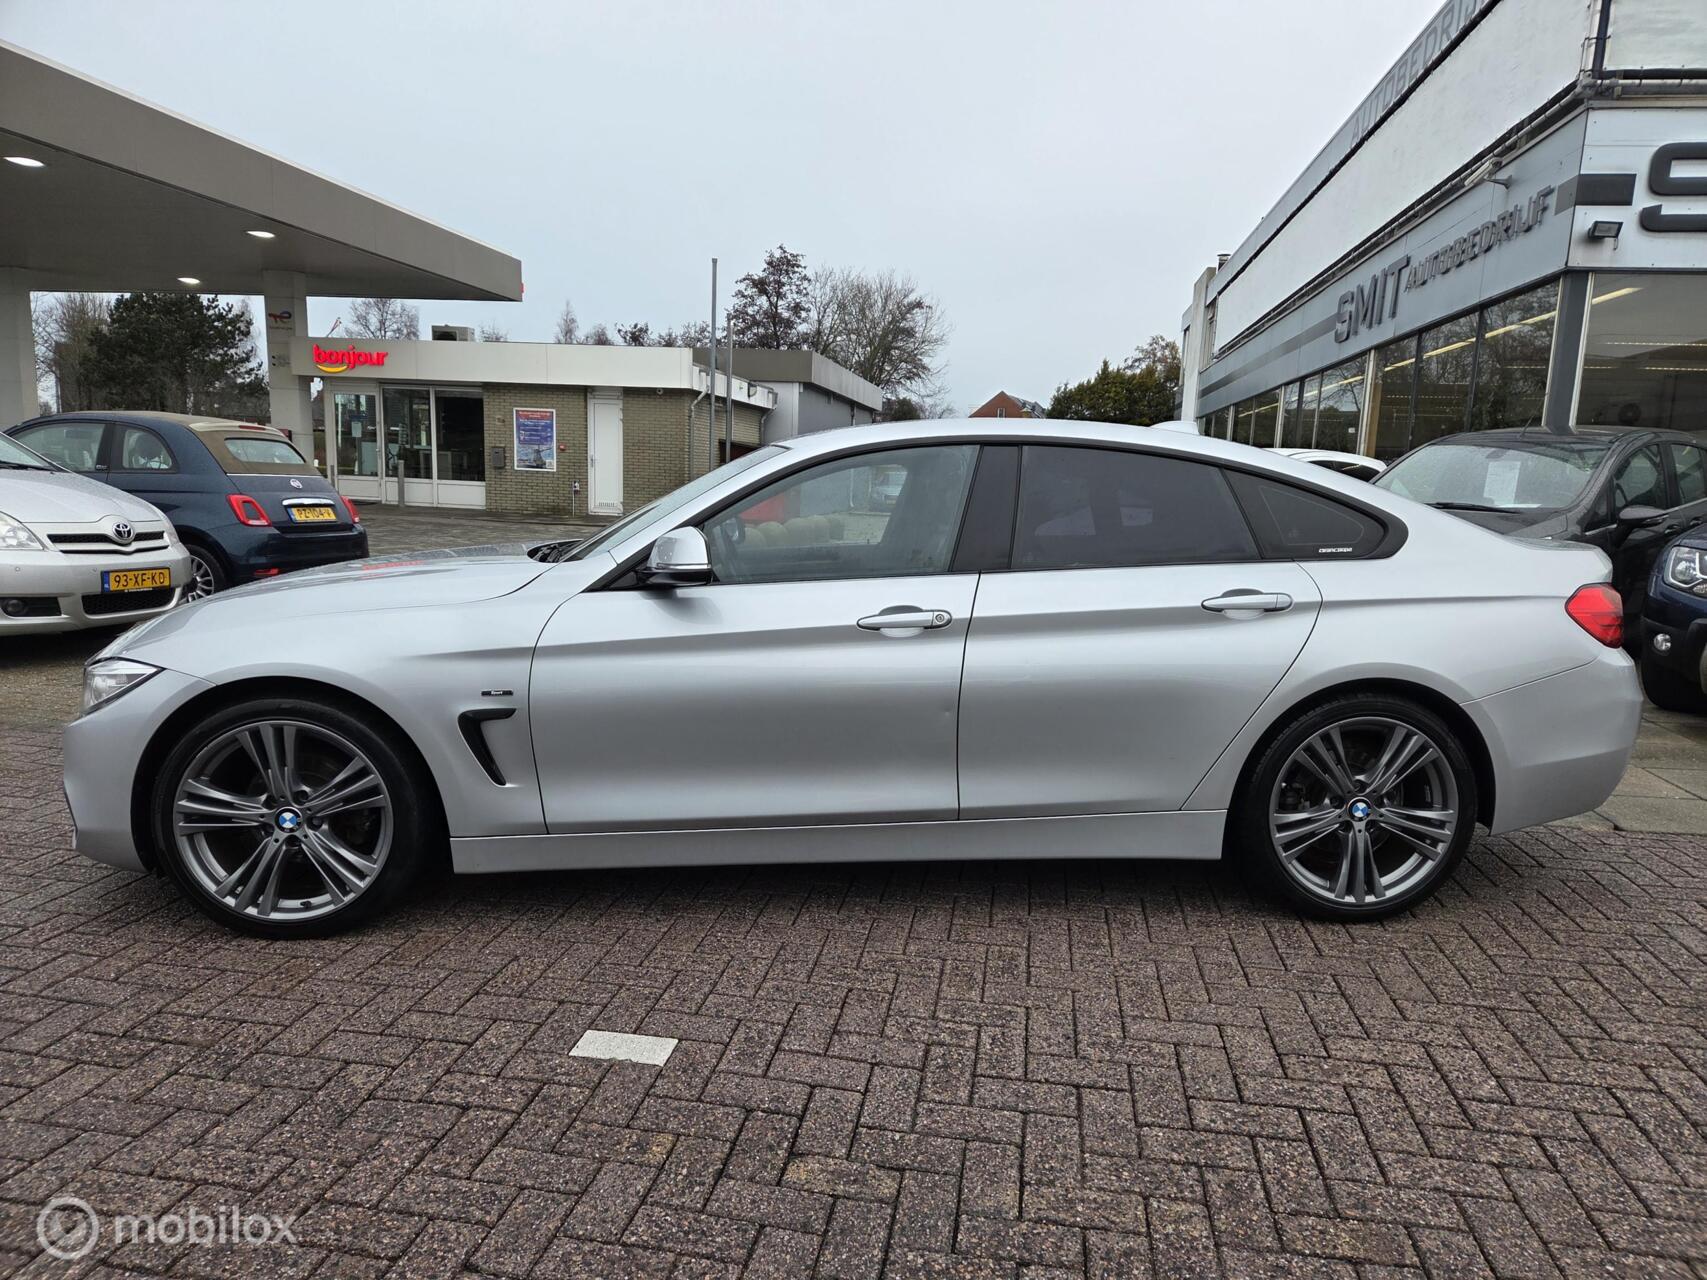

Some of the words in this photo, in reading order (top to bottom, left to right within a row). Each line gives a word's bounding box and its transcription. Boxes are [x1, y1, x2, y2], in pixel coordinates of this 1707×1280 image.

[1352, 0, 1487, 142] AUTOBEDRIJ
[1335, 254, 1411, 344] SMIT
[1404, 185, 1554, 293] AUTOBEDRIJF
[313, 343, 388, 370] bonjour
[114, 571, 165, 588] 93-XF-KD
